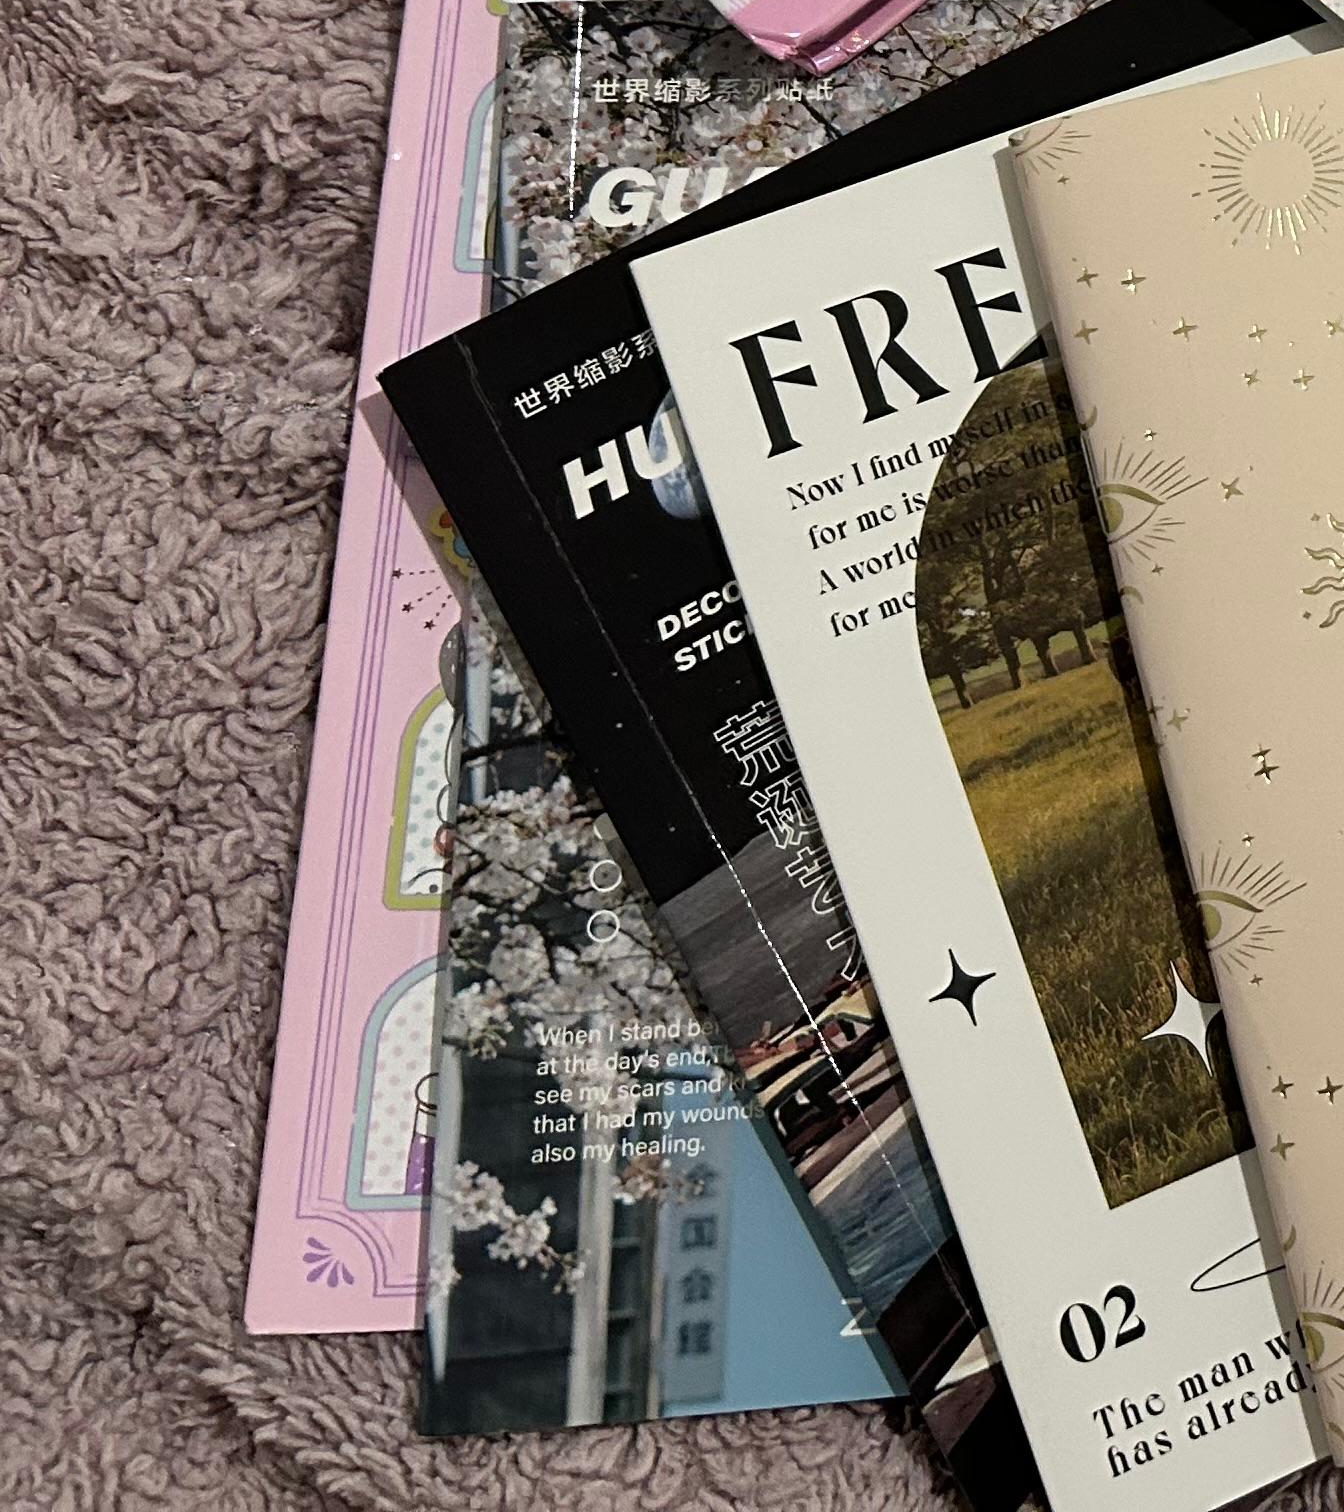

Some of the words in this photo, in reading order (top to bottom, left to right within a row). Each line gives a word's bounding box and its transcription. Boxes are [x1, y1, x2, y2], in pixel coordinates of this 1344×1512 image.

[592, 76, 836, 105] 世界缩影系列贴纸
[589, 167, 783, 228] GU
[786, 471, 844, 511] Now
[852, 461, 864, 487] I
[870, 443, 922, 480] find
[808, 518, 847, 551] for
[857, 502, 897, 534] me
[903, 491, 928, 516] is
[818, 567, 840, 596] A
[843, 535, 921, 584] world
[673, 608, 754, 673] STIC
[829, 606, 870, 638] for
[536, 1057, 558, 1076] at
[564, 1053, 599, 1074] the
[606, 1049, 660, 1075] day's
[540, 1024, 601, 1047] When
[621, 1019, 681, 1043] stand
[534, 1088, 573, 1106] see
[579, 1085, 611, 1105] my
[617, 1079, 676, 1100] scars
[681, 1075, 722, 1094] and
[531, 1144, 576, 1165] also
[582, 1143, 616, 1164] my
[621, 1133, 706, 1159] healing.
[533, 1114, 577, 1135] that
[595, 1110, 636, 1130] had
[643, 1111, 675, 1131] my
[1058, 1283, 1147, 1365] 02
[1092, 1392, 1166, 1440] The
[1177, 1351, 1256, 1403] man
[1106, 1430, 1174, 1478] has
[1187, 1360, 1317, 1440] alread
